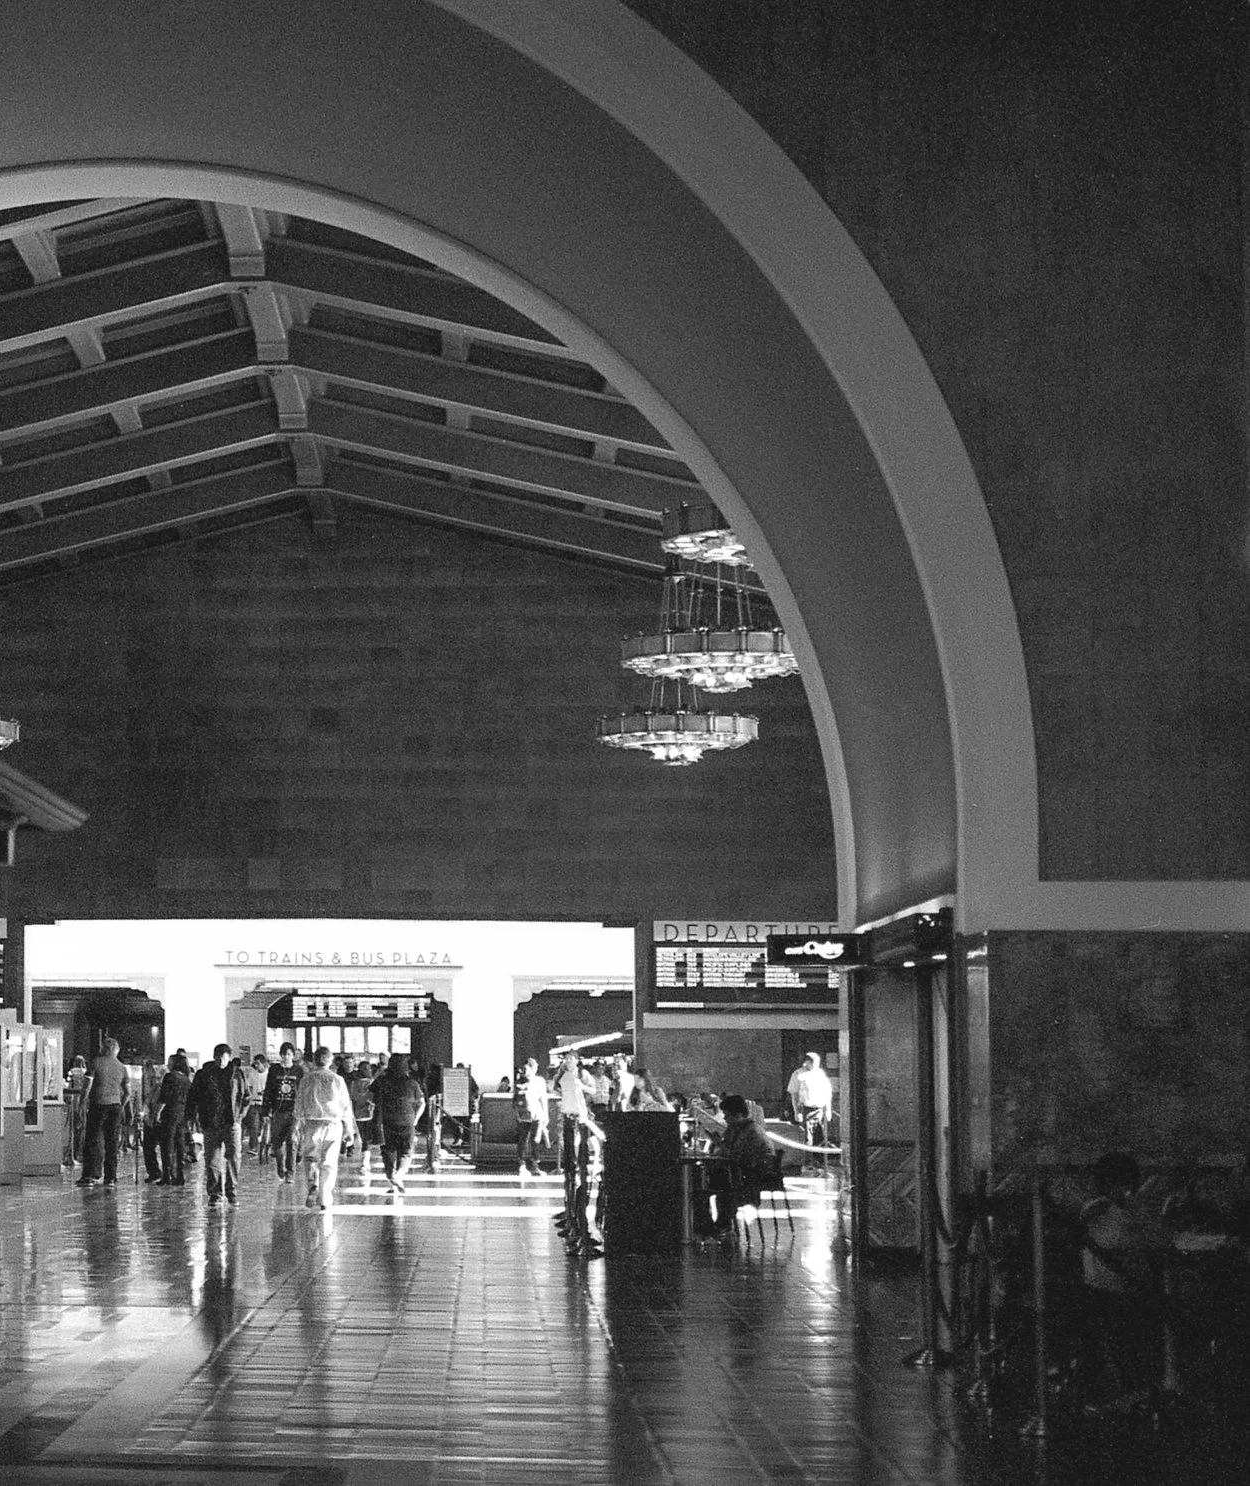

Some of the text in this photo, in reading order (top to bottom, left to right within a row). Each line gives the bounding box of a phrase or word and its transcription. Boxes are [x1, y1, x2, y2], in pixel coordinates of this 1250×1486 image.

[225, 950, 453, 966] TO TRAINS & BUS PLAZA
